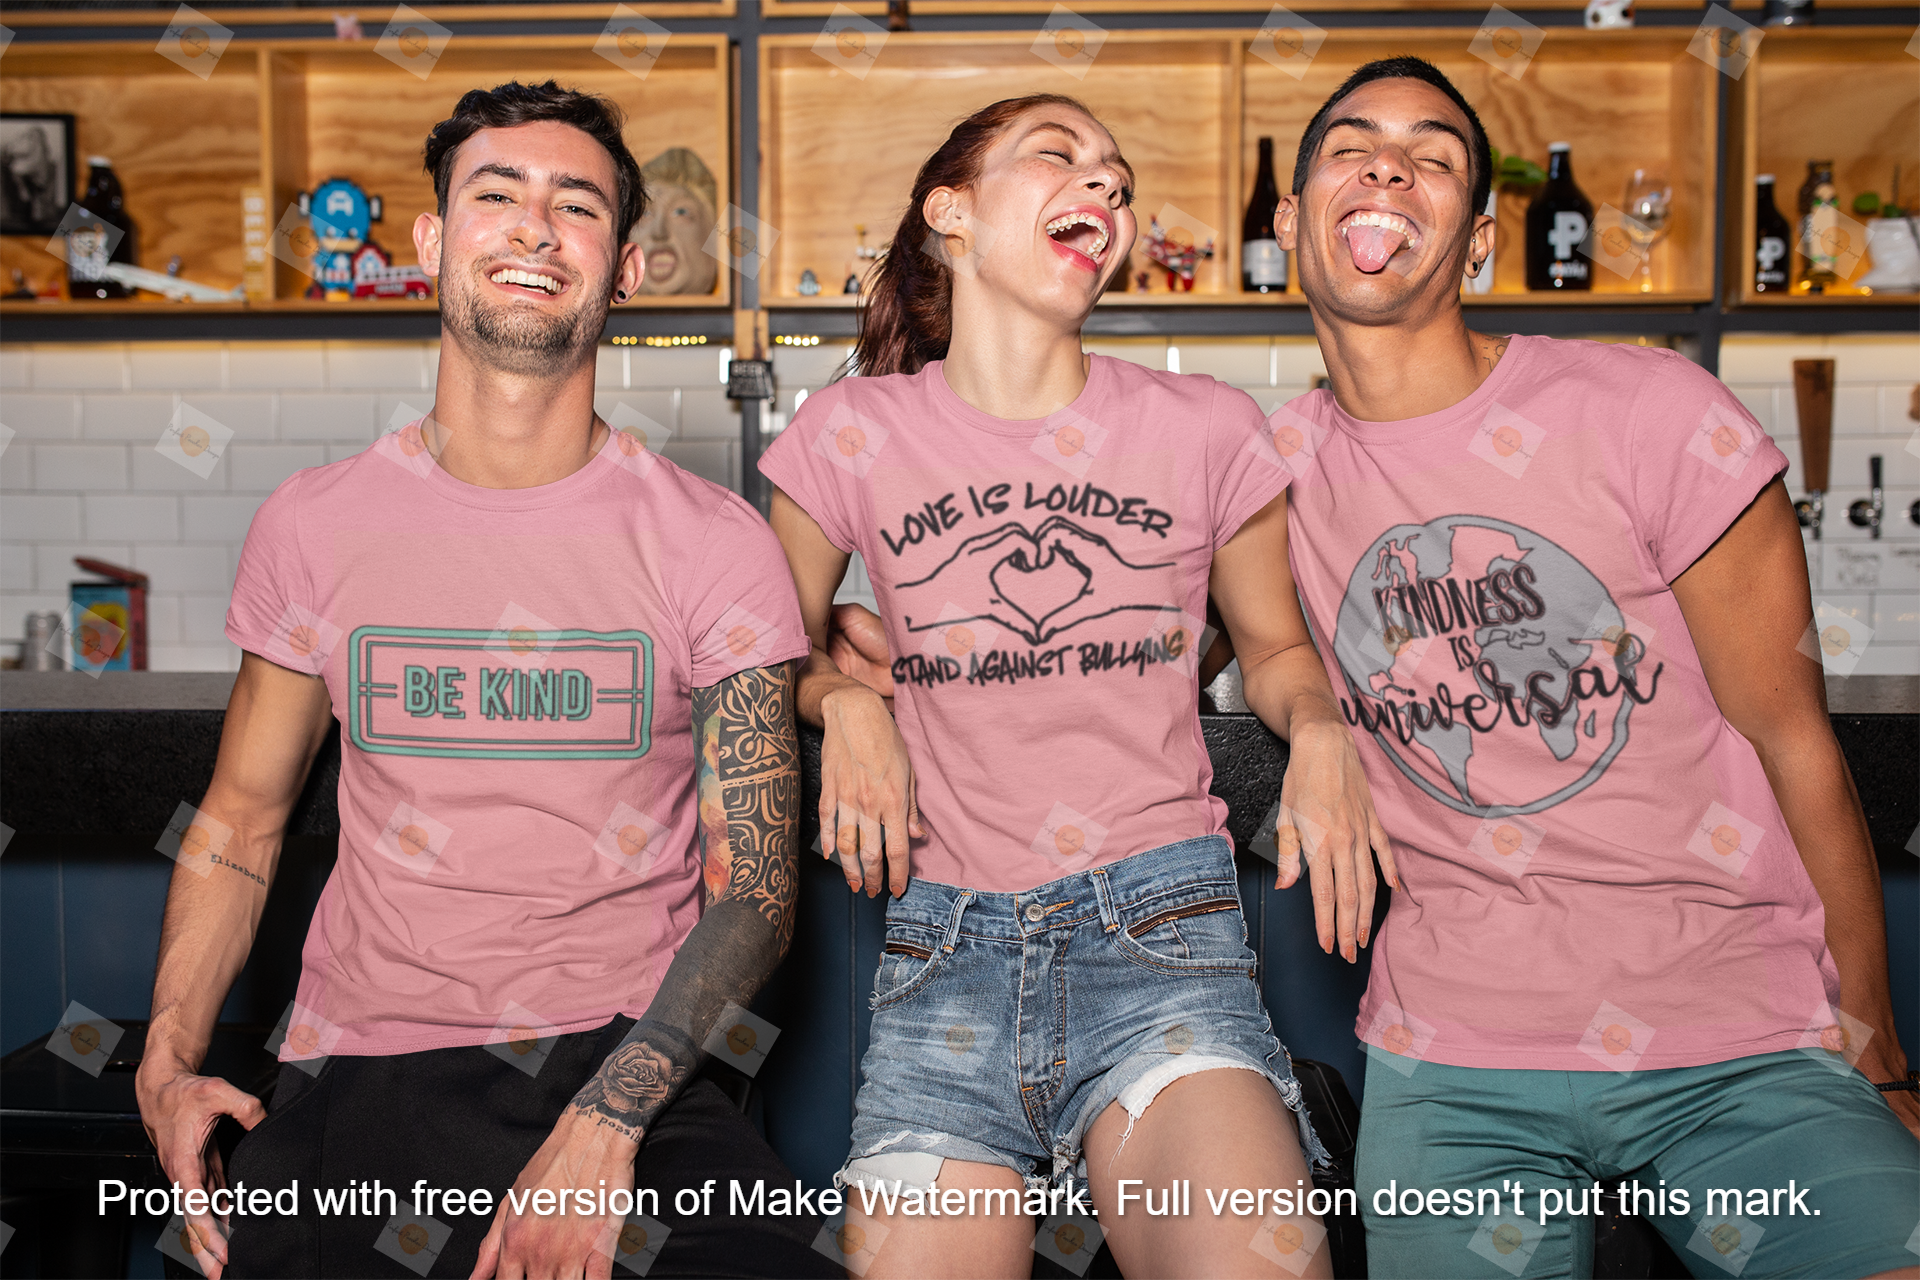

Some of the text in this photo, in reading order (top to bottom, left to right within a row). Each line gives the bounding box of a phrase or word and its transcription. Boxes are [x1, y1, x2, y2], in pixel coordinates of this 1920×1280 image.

[880, 482, 1173, 556] LOVE IS LOUDER
[1373, 563, 1546, 642] KINDNESS
[891, 653, 962, 689] STAND
[966, 644, 1074, 687] AGAINST
[1077, 629, 1185, 677] BULLYING
[1447, 634, 1475, 672] IS
[404, 664, 593, 722] BE KIND
[1339, 632, 1665, 746] universal
[210, 854, 266, 887] Elizabeth
